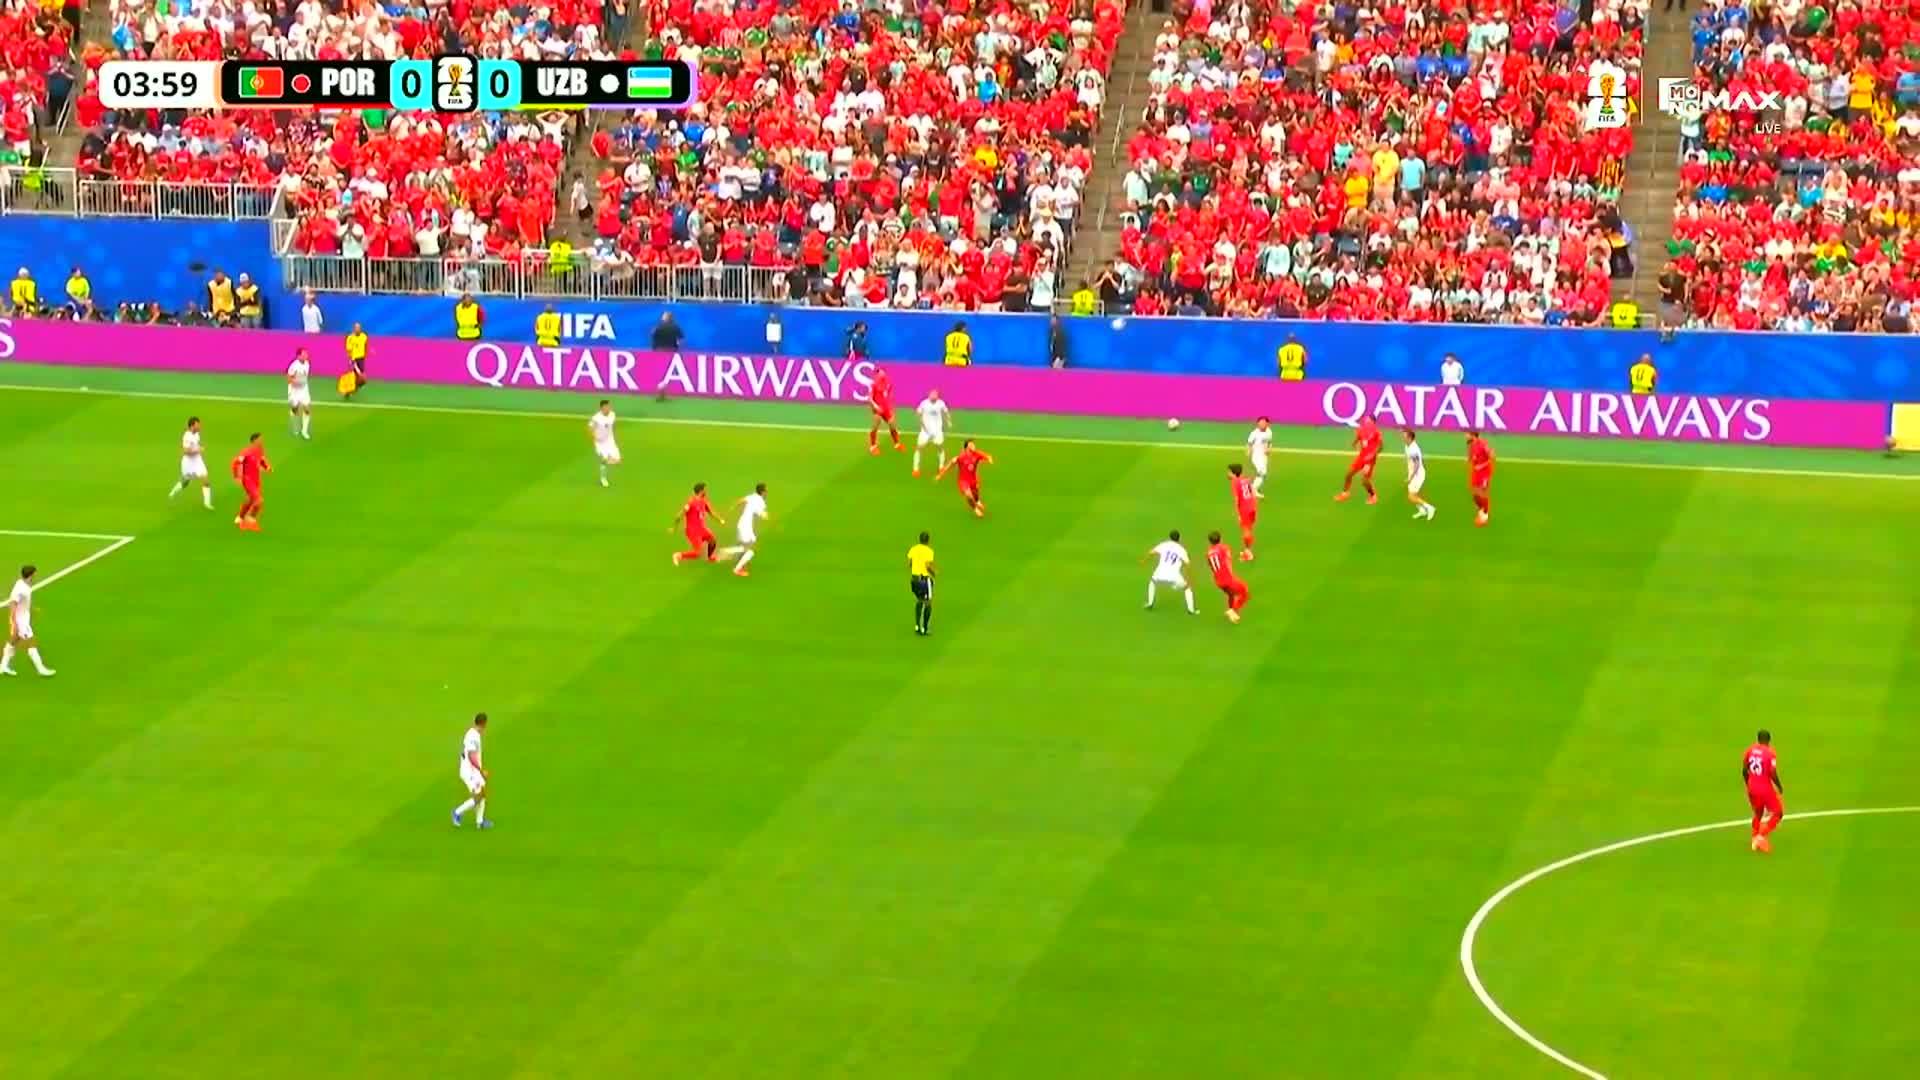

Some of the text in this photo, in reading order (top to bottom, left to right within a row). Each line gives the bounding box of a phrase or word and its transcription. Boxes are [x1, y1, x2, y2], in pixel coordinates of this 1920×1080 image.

[559, 313, 616, 339] IFA
[466, 343, 877, 401] QATAR AIRWAYS
[1322, 382, 1771, 440] QATAR AIRWAYS
[1165, 550, 1178, 565] 19
